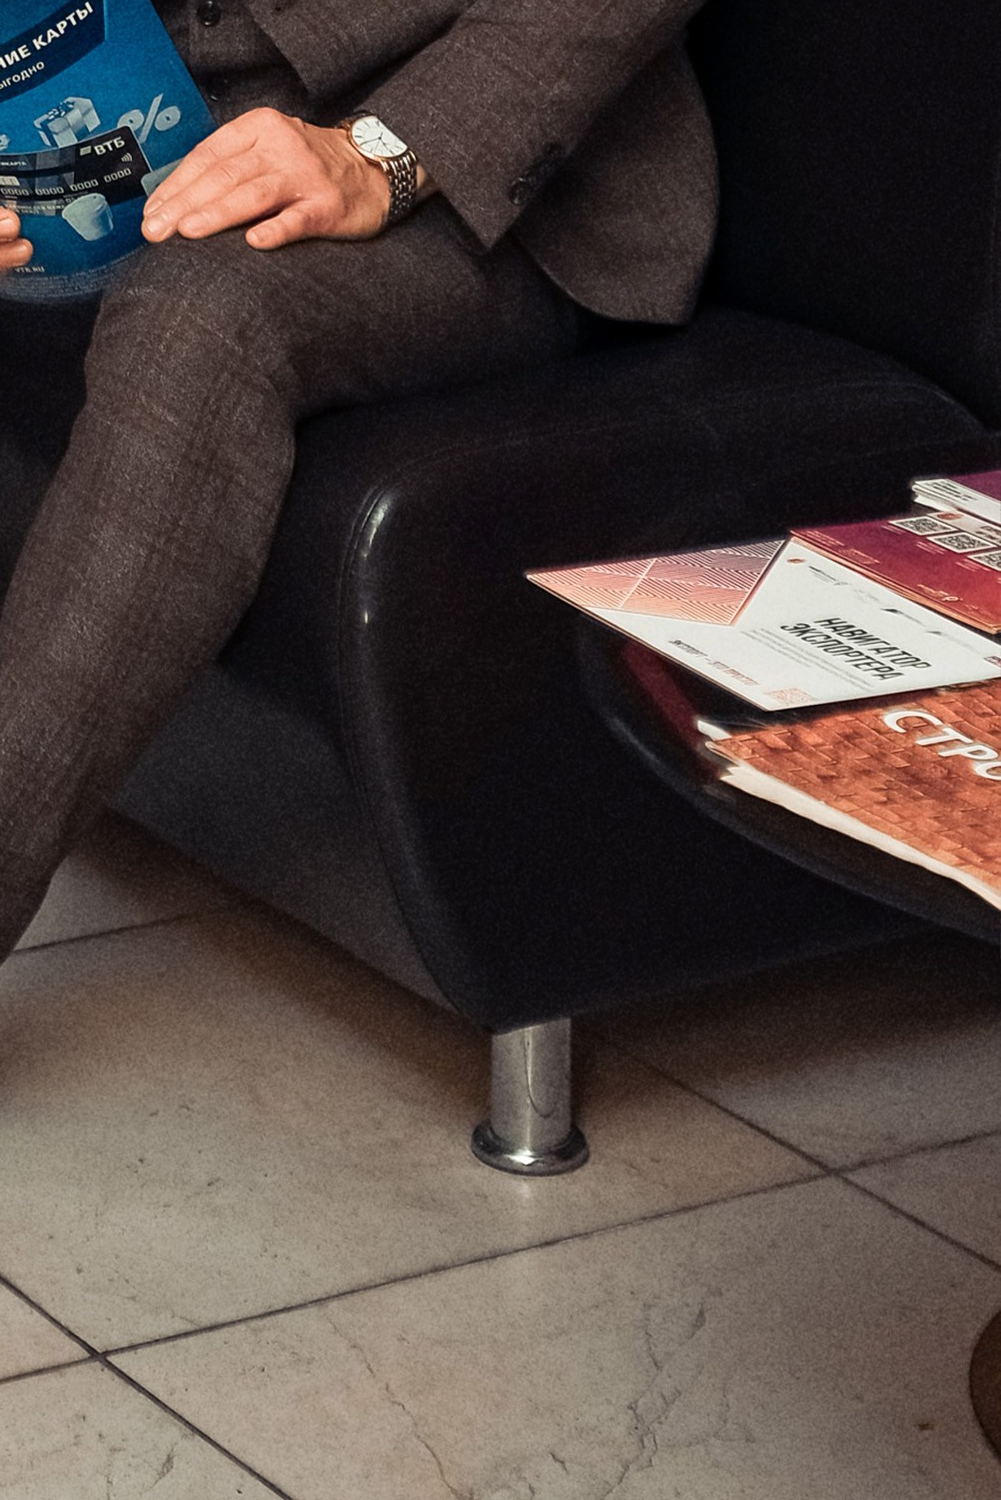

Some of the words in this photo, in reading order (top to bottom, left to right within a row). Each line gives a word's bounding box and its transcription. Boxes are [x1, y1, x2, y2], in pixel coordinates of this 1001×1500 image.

[32, 1, 94, 51] КАРТЫ
[93, 136, 126, 156] ВТБ
[35, 186, 64, 196] 0000
[70, 178, 99, 192] 0000
[103, 167, 132, 183] 0000
[780, 622, 905, 681] ЭКСПОРТЕРА
[814, 617, 932, 669] НАВИГАТОР
